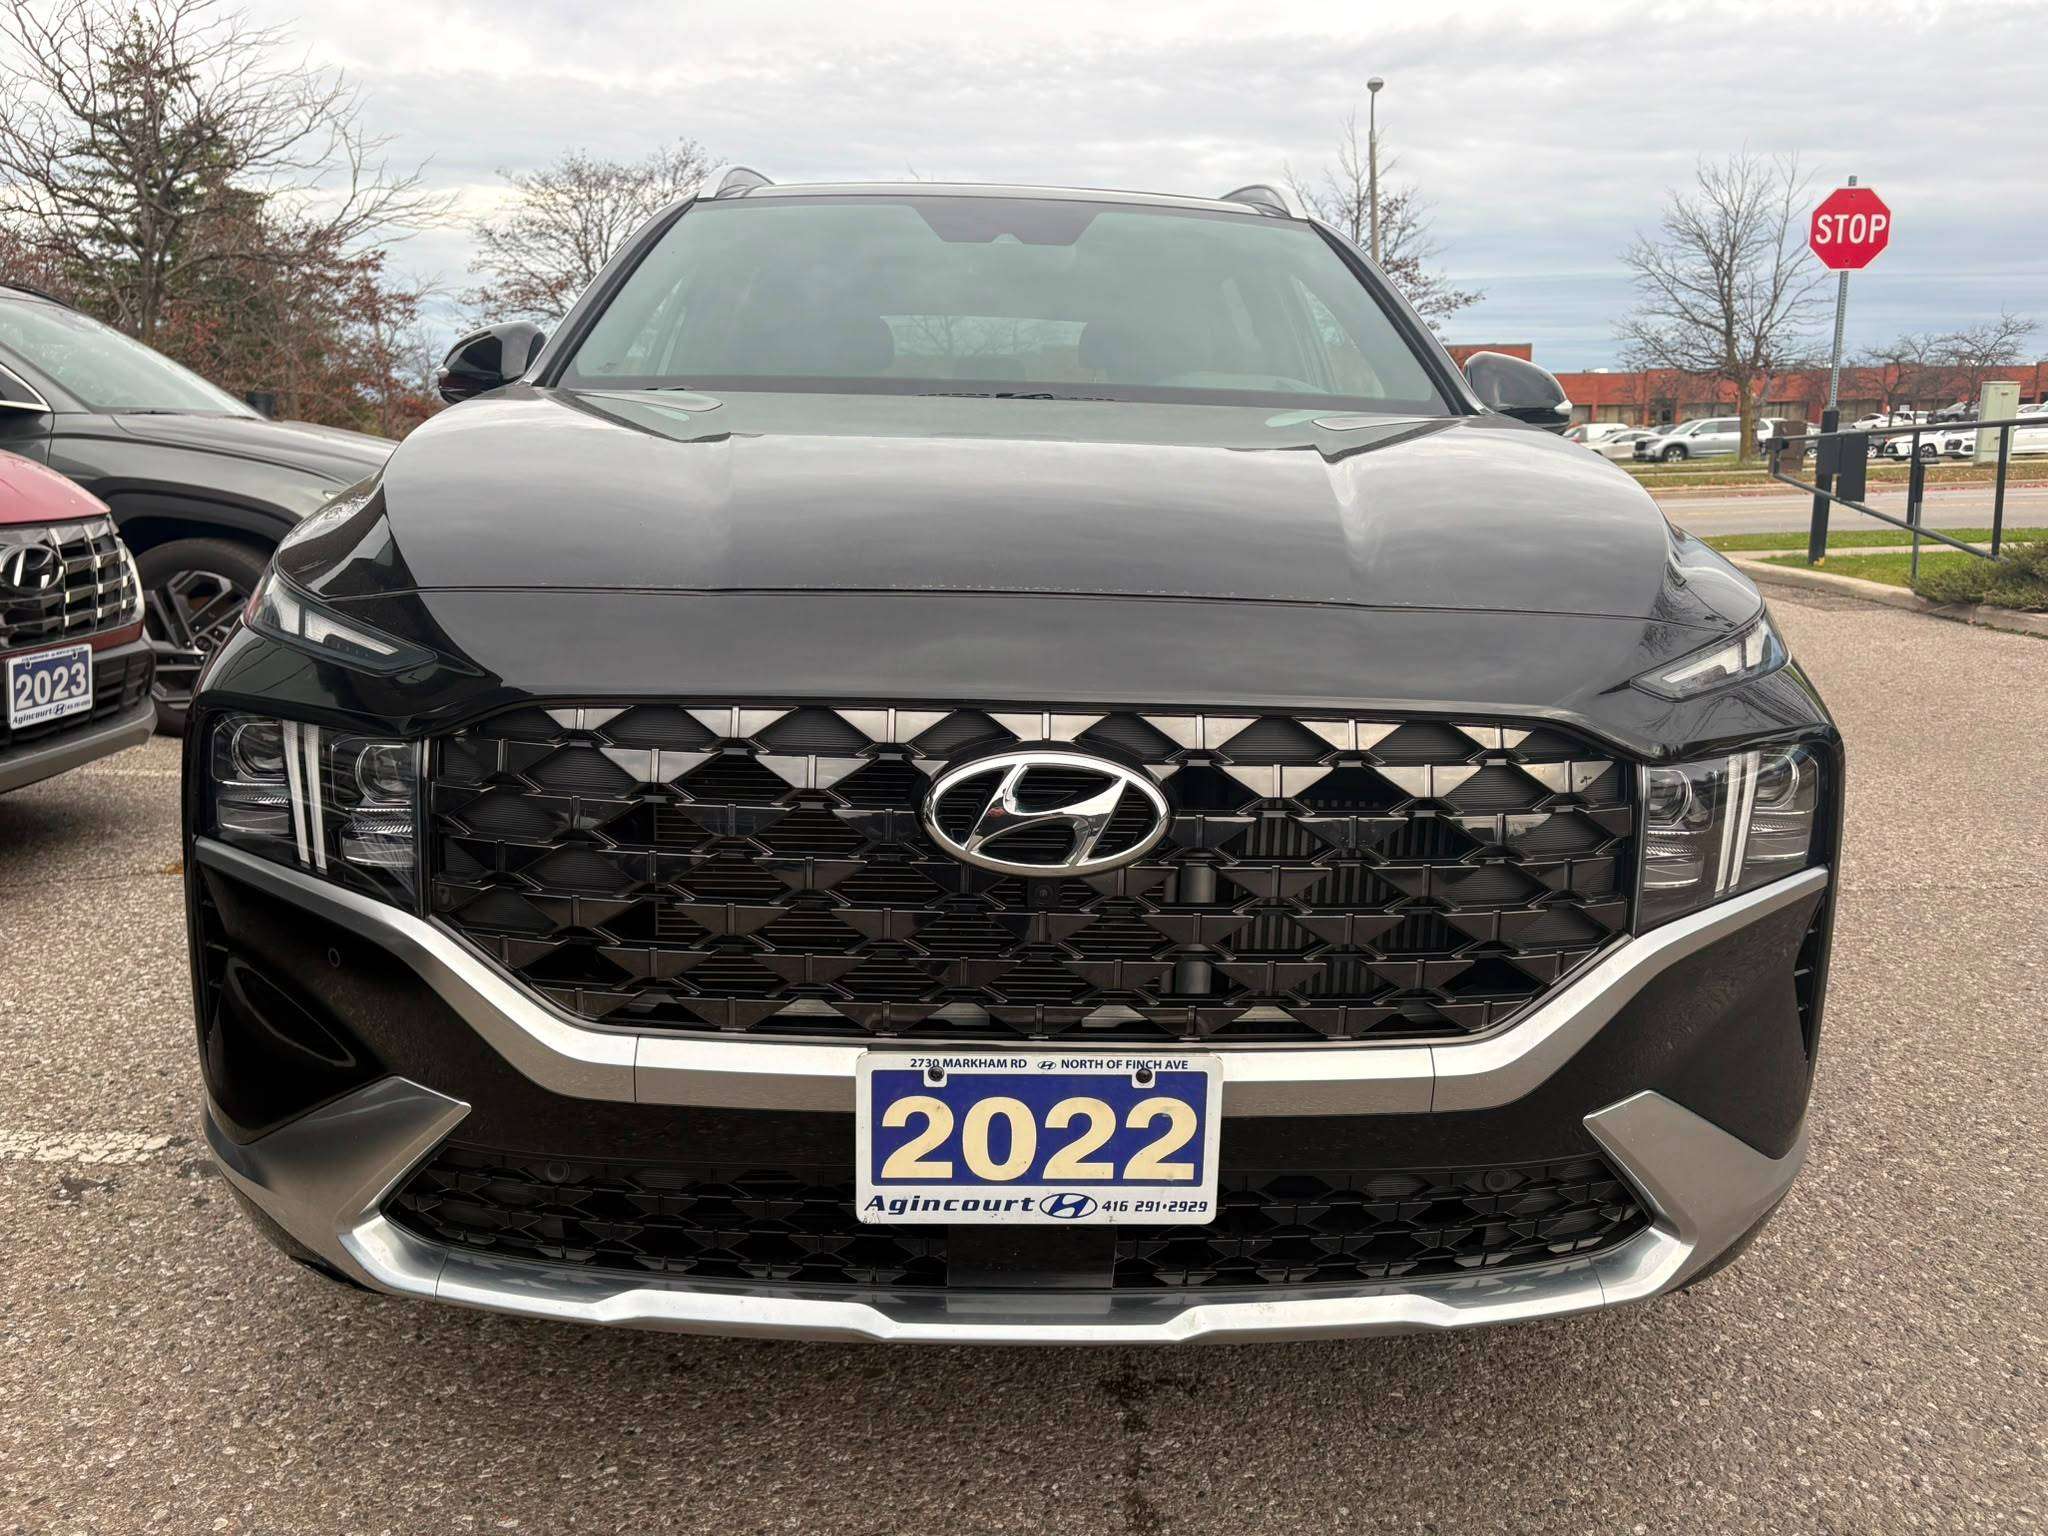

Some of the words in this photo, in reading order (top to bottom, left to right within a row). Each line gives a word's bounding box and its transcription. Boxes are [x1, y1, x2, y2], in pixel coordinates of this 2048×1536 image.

[1815, 213, 1887, 244] STOP
[15, 662, 87, 711] 2023
[910, 1058, 940, 1068] 2730
[942, 1058, 1008, 1069] MARKHAM
[1010, 1059, 1028, 1069] RD
[1061, 1059, 1103, 1069] NORTH
[1106, 1059, 1123, 1070] OF
[1126, 1060, 1162, 1070] FINCH
[1164, 1060, 1189, 1070] AVE
[880, 1095, 1198, 1181] 2022
[864, 1195, 1036, 1215] Agincourt
[1101, 1200, 1128, 1212] 416
